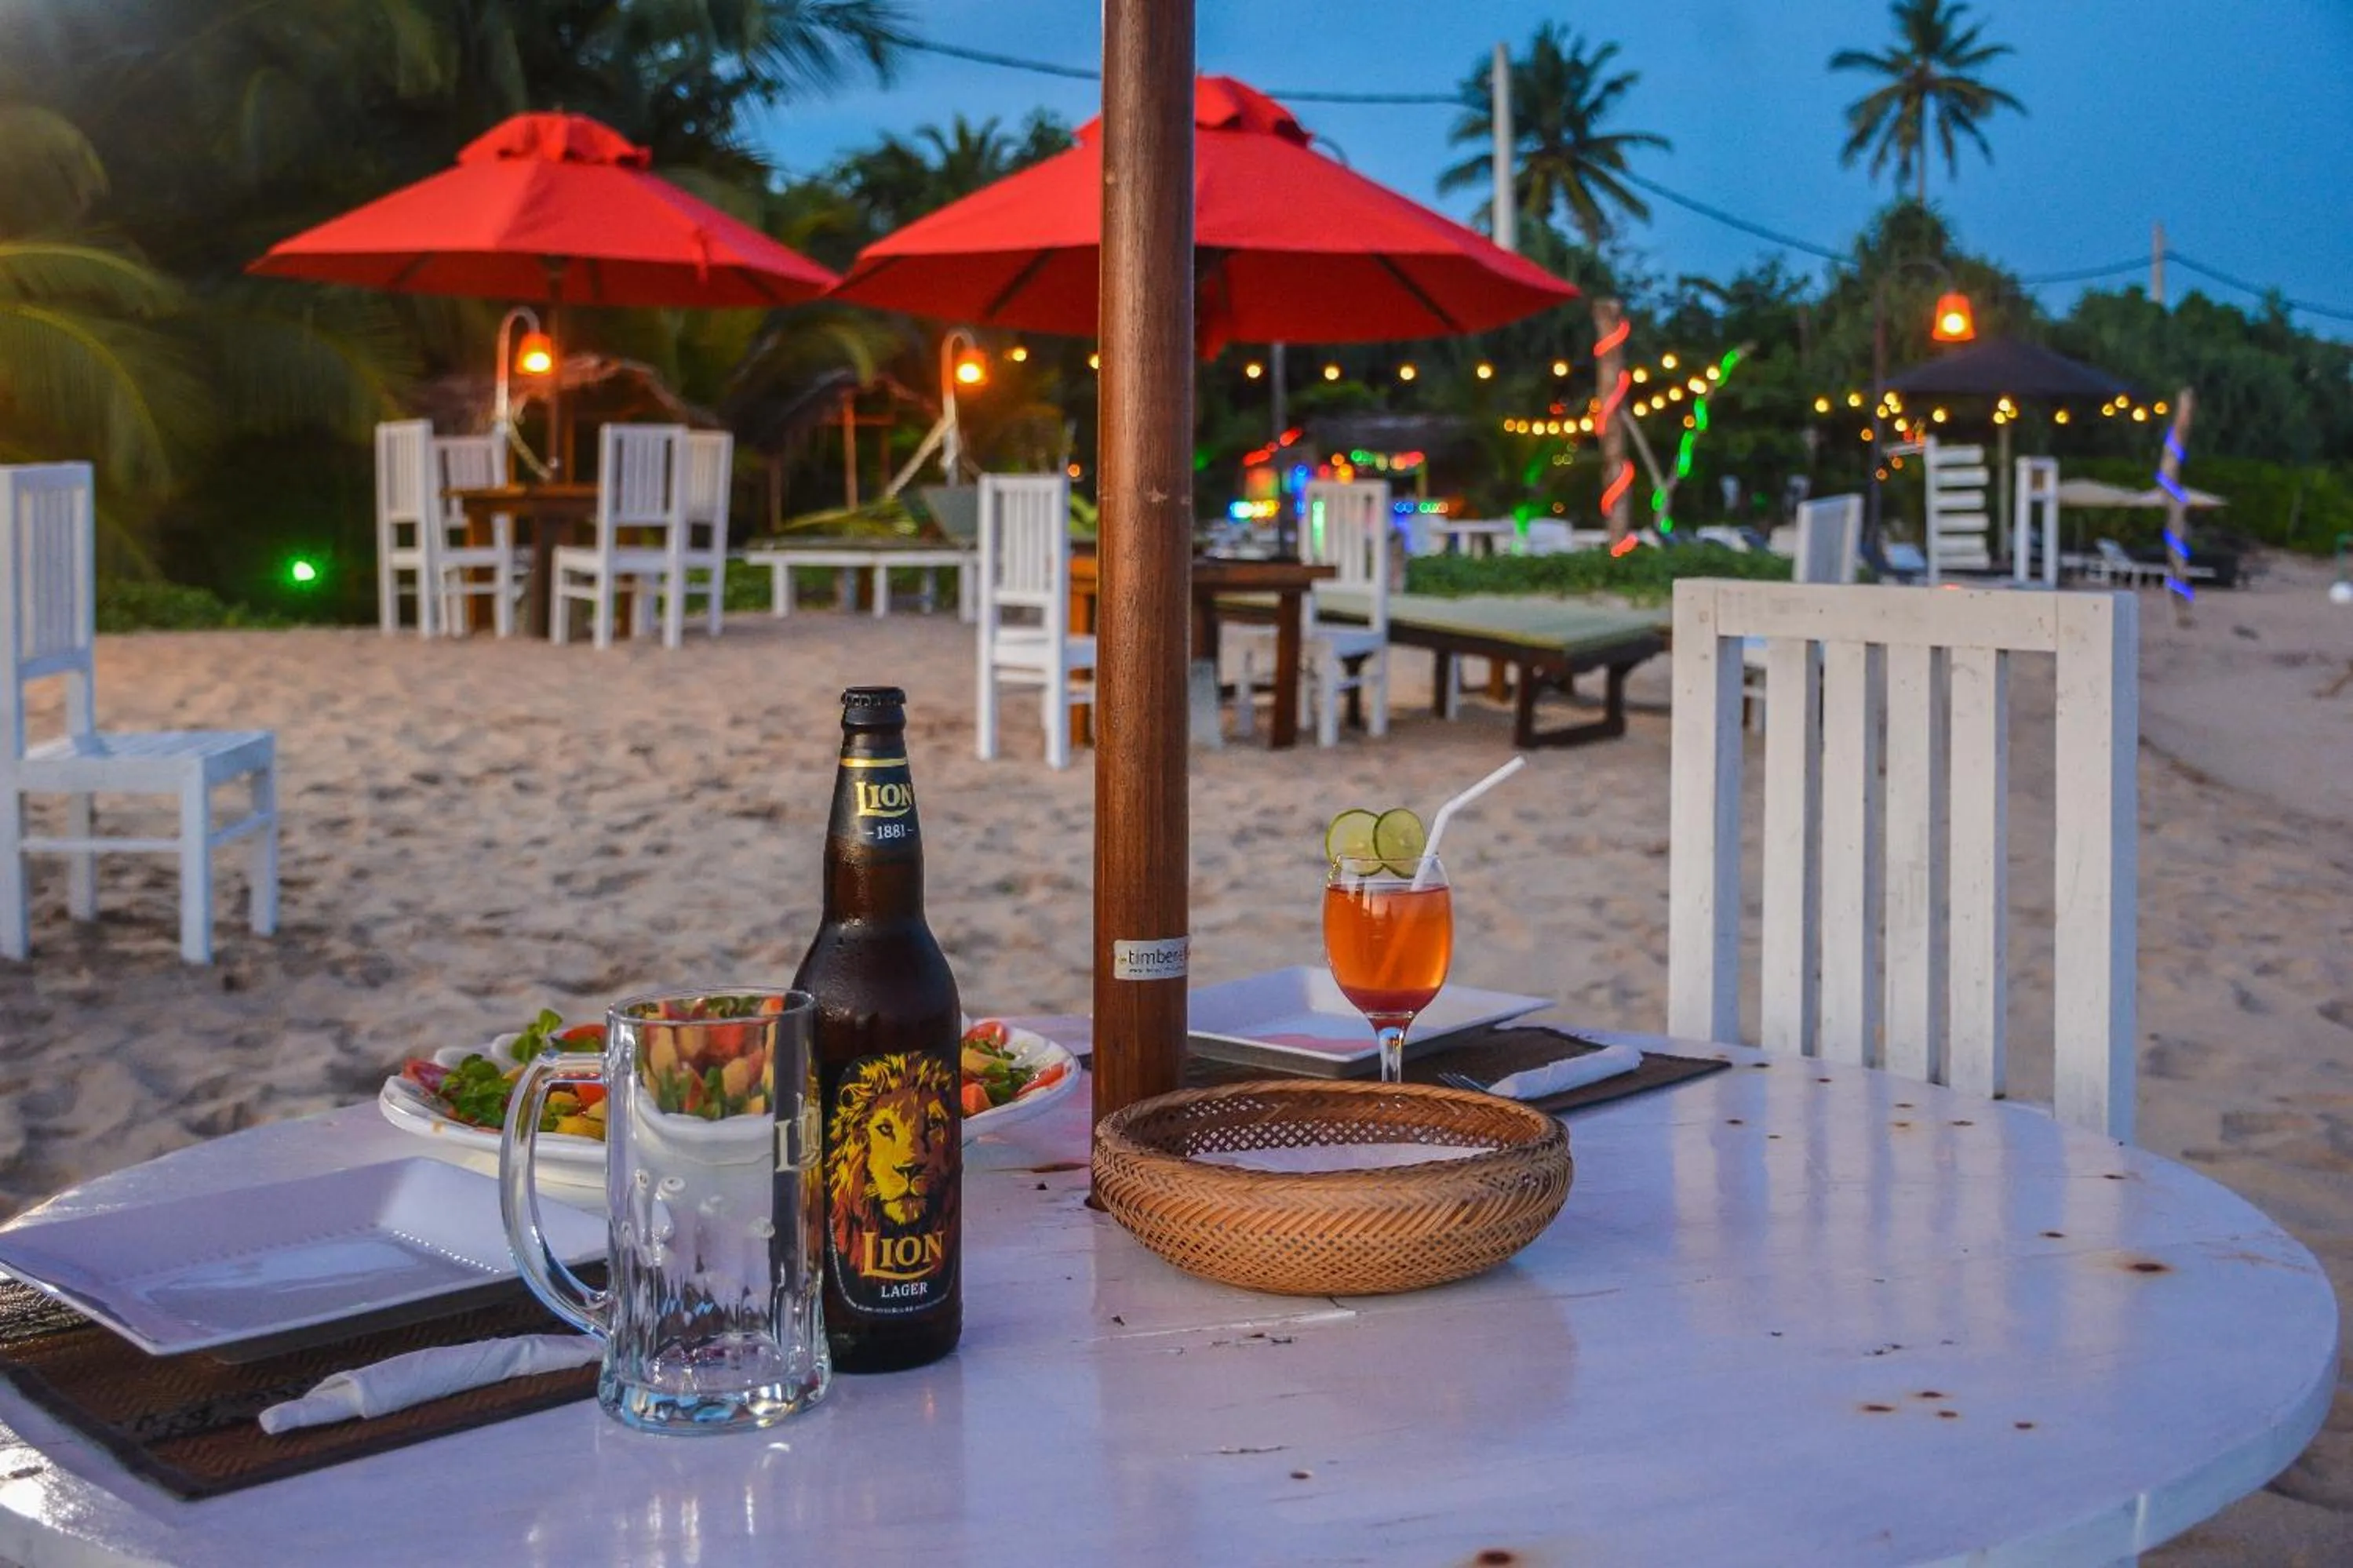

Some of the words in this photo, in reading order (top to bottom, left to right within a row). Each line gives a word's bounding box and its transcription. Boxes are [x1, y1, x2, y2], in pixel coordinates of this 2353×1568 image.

[854, 781, 913, 817] LION
[861, 1231, 944, 1280] LION
[881, 1282, 928, 1298] LAGER
